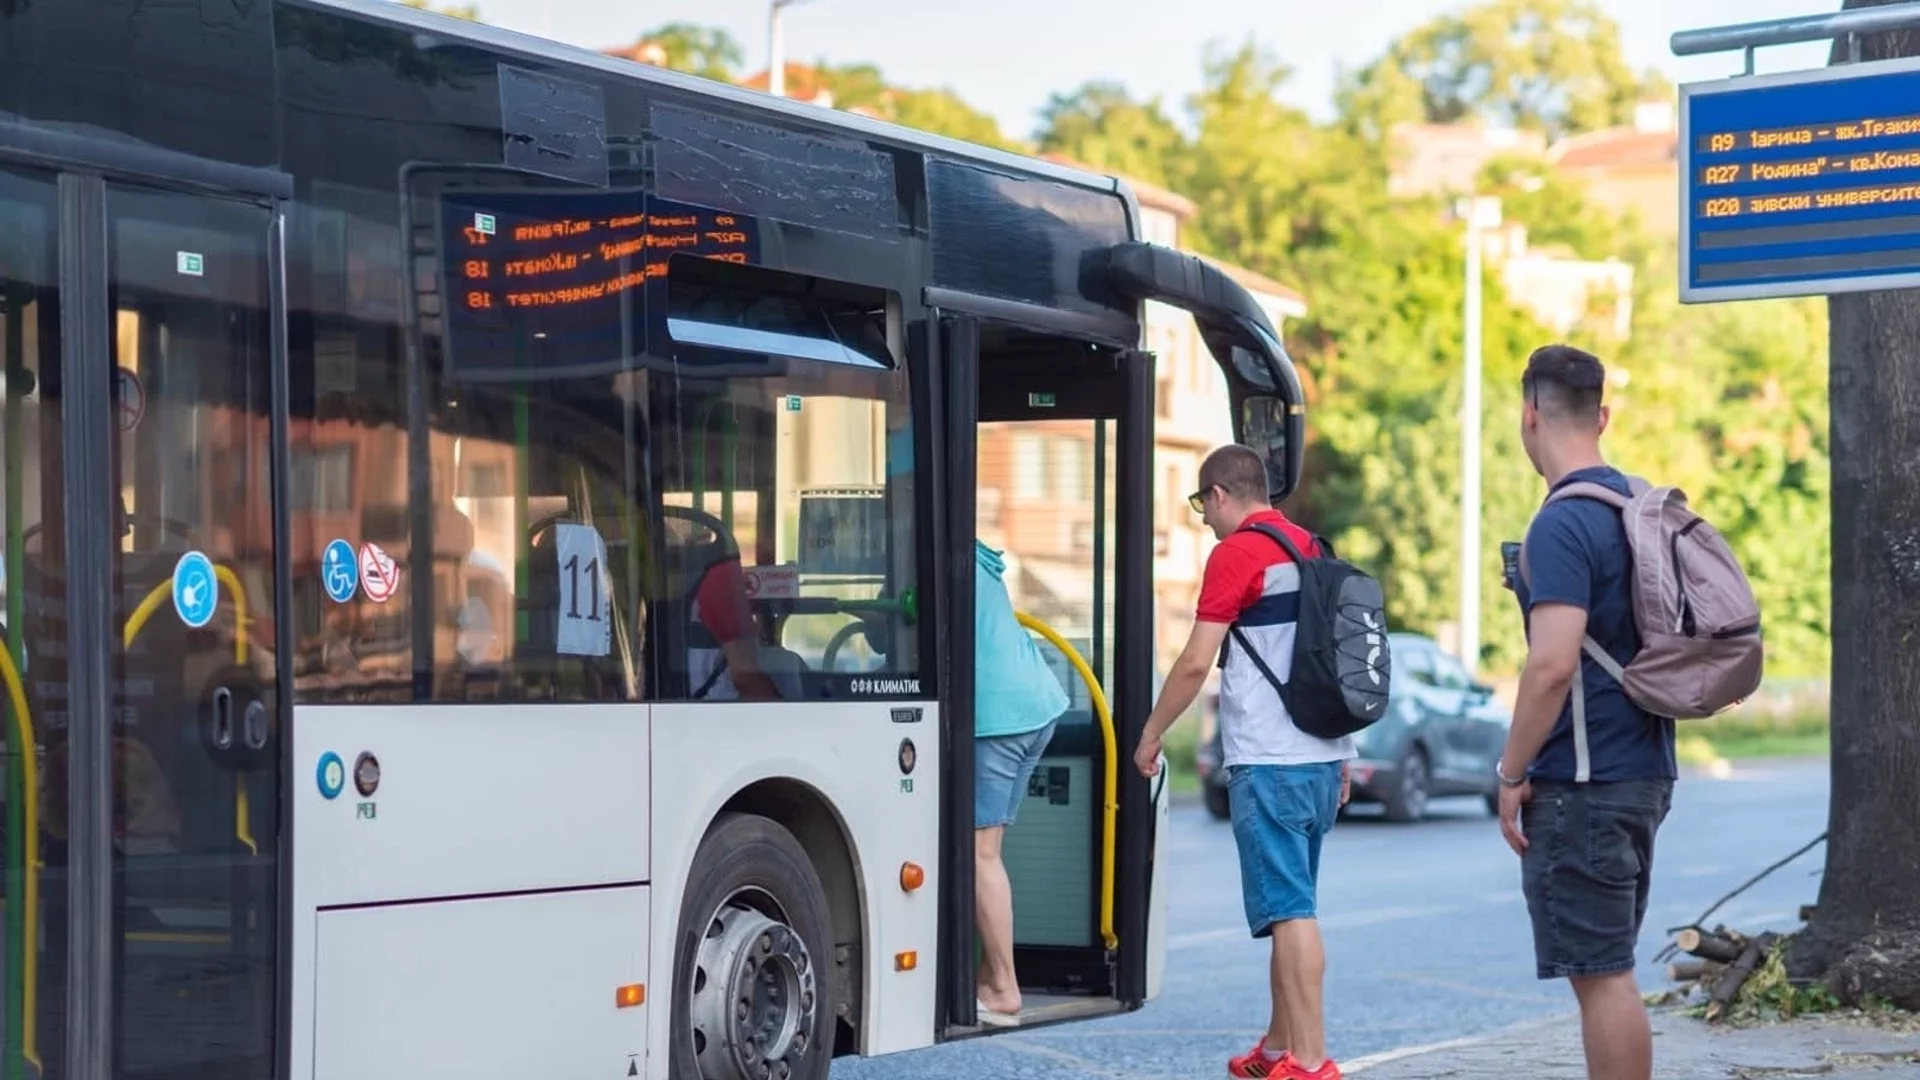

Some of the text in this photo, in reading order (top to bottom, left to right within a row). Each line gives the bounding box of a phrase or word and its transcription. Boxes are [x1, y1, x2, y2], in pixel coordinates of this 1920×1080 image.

[1712, 133, 1734, 151] А9
[1706, 165, 1739, 184] А27
[564, 555, 601, 621] 11
[874, 679, 920, 693] КЛИМАТИК
